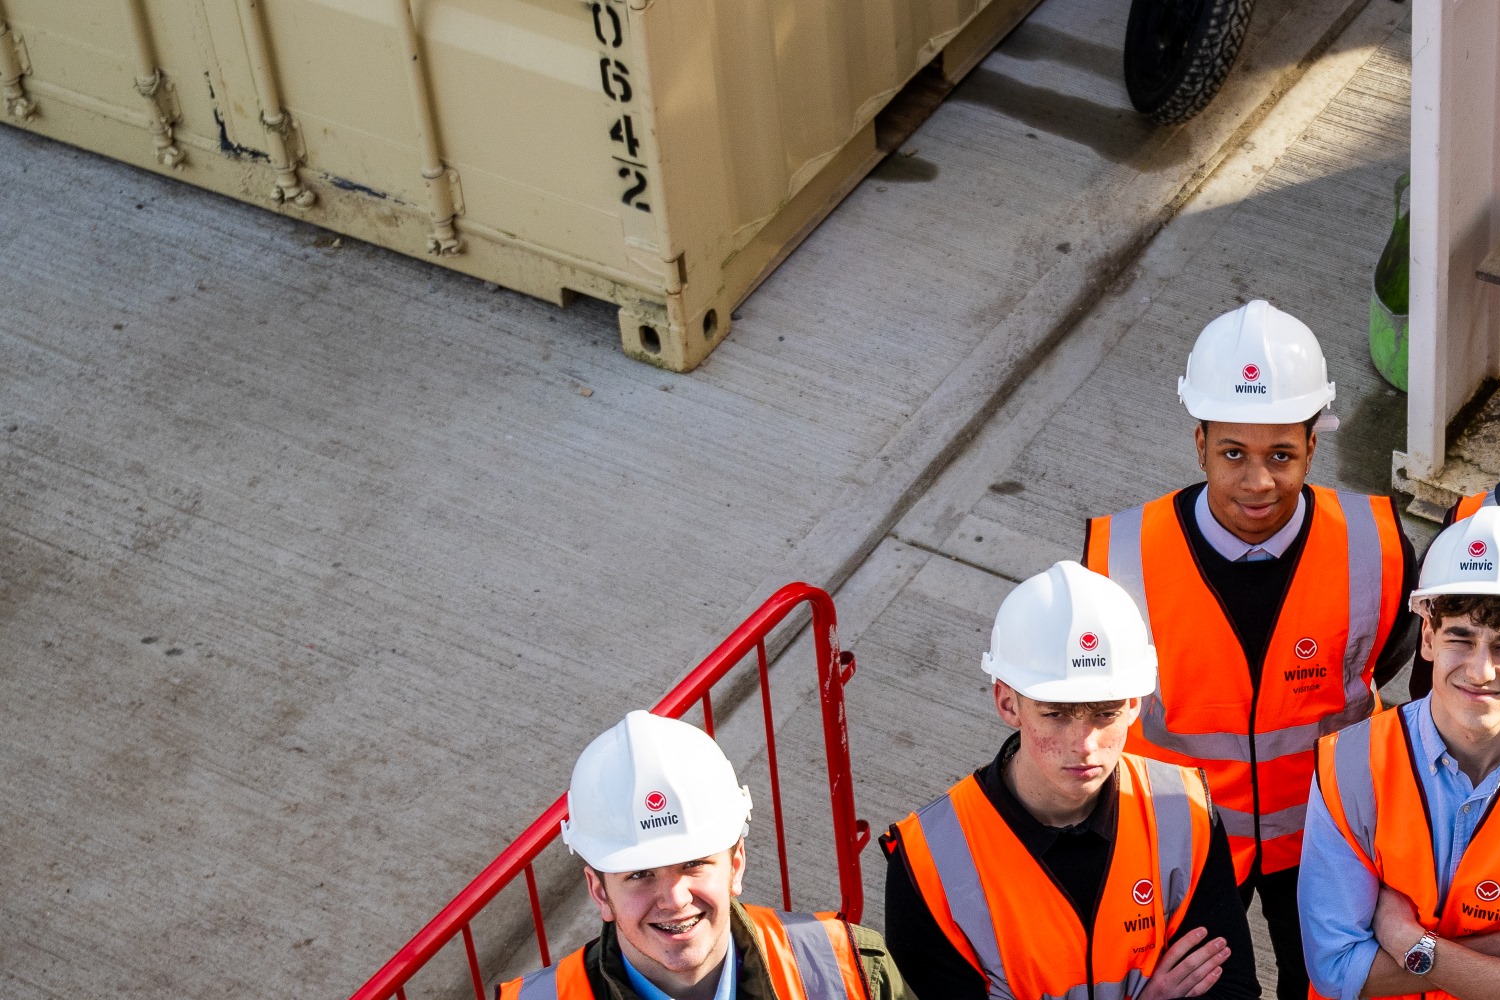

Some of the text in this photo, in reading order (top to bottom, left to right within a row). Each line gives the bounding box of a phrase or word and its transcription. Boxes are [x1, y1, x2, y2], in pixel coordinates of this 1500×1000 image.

[1235, 382, 1267, 394] winvic
[1460, 559, 1493, 571] winvic
[1072, 654, 1106, 668] winvic
[1284, 663, 1327, 682] winvic
[1293, 683, 1320, 694] VISITOR
[640, 812, 679, 830] winvic
[1124, 913, 1156, 933] winv
[1132, 943, 1156, 954] VISITO
